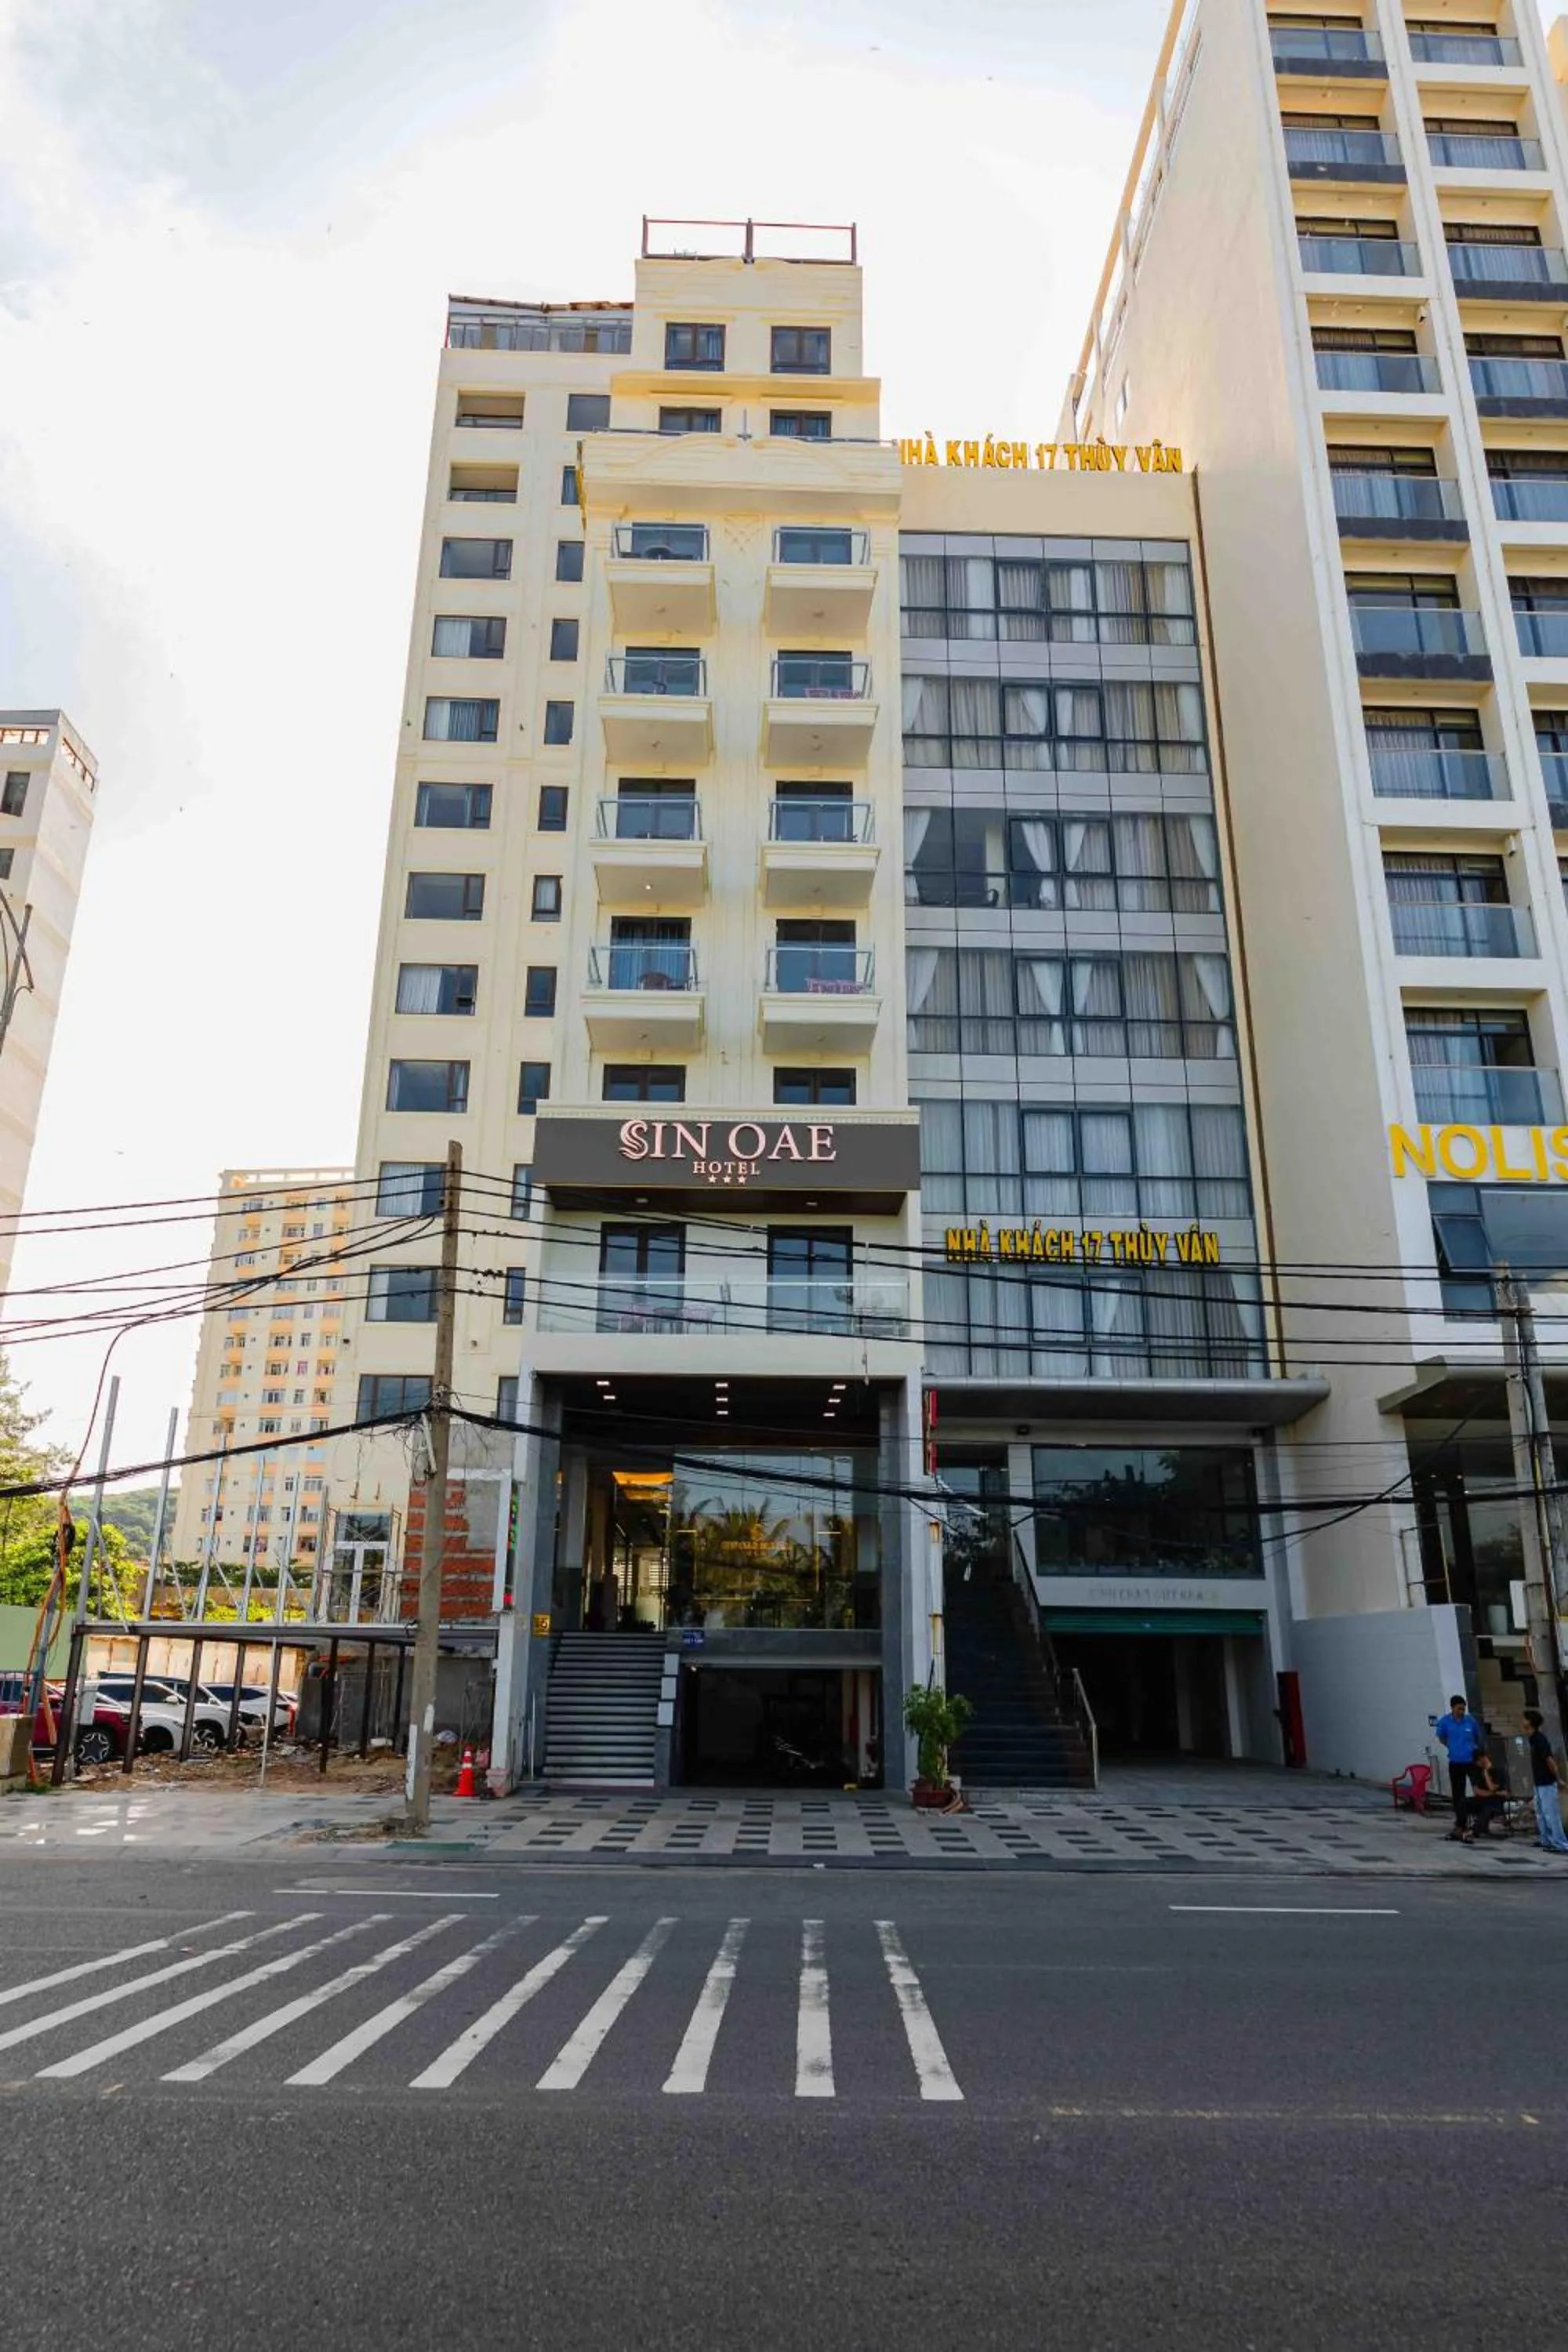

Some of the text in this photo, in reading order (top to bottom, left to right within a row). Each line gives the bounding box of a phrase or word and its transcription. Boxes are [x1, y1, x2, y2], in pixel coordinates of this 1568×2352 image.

[946, 433, 1027, 469] KHÁCH
[1036, 443, 1057, 470] 17
[1135, 438, 1182, 473] VÂN
[619, 1119, 837, 1161] SIN OAE
[693, 1161, 760, 1175] HOTEL
[946, 1219, 991, 1262] NHÀ
[998, 1219, 1075, 1263] KHÁCH
[1081, 1230, 1102, 1263] 17
[1175, 1224, 1220, 1265] VÂN
